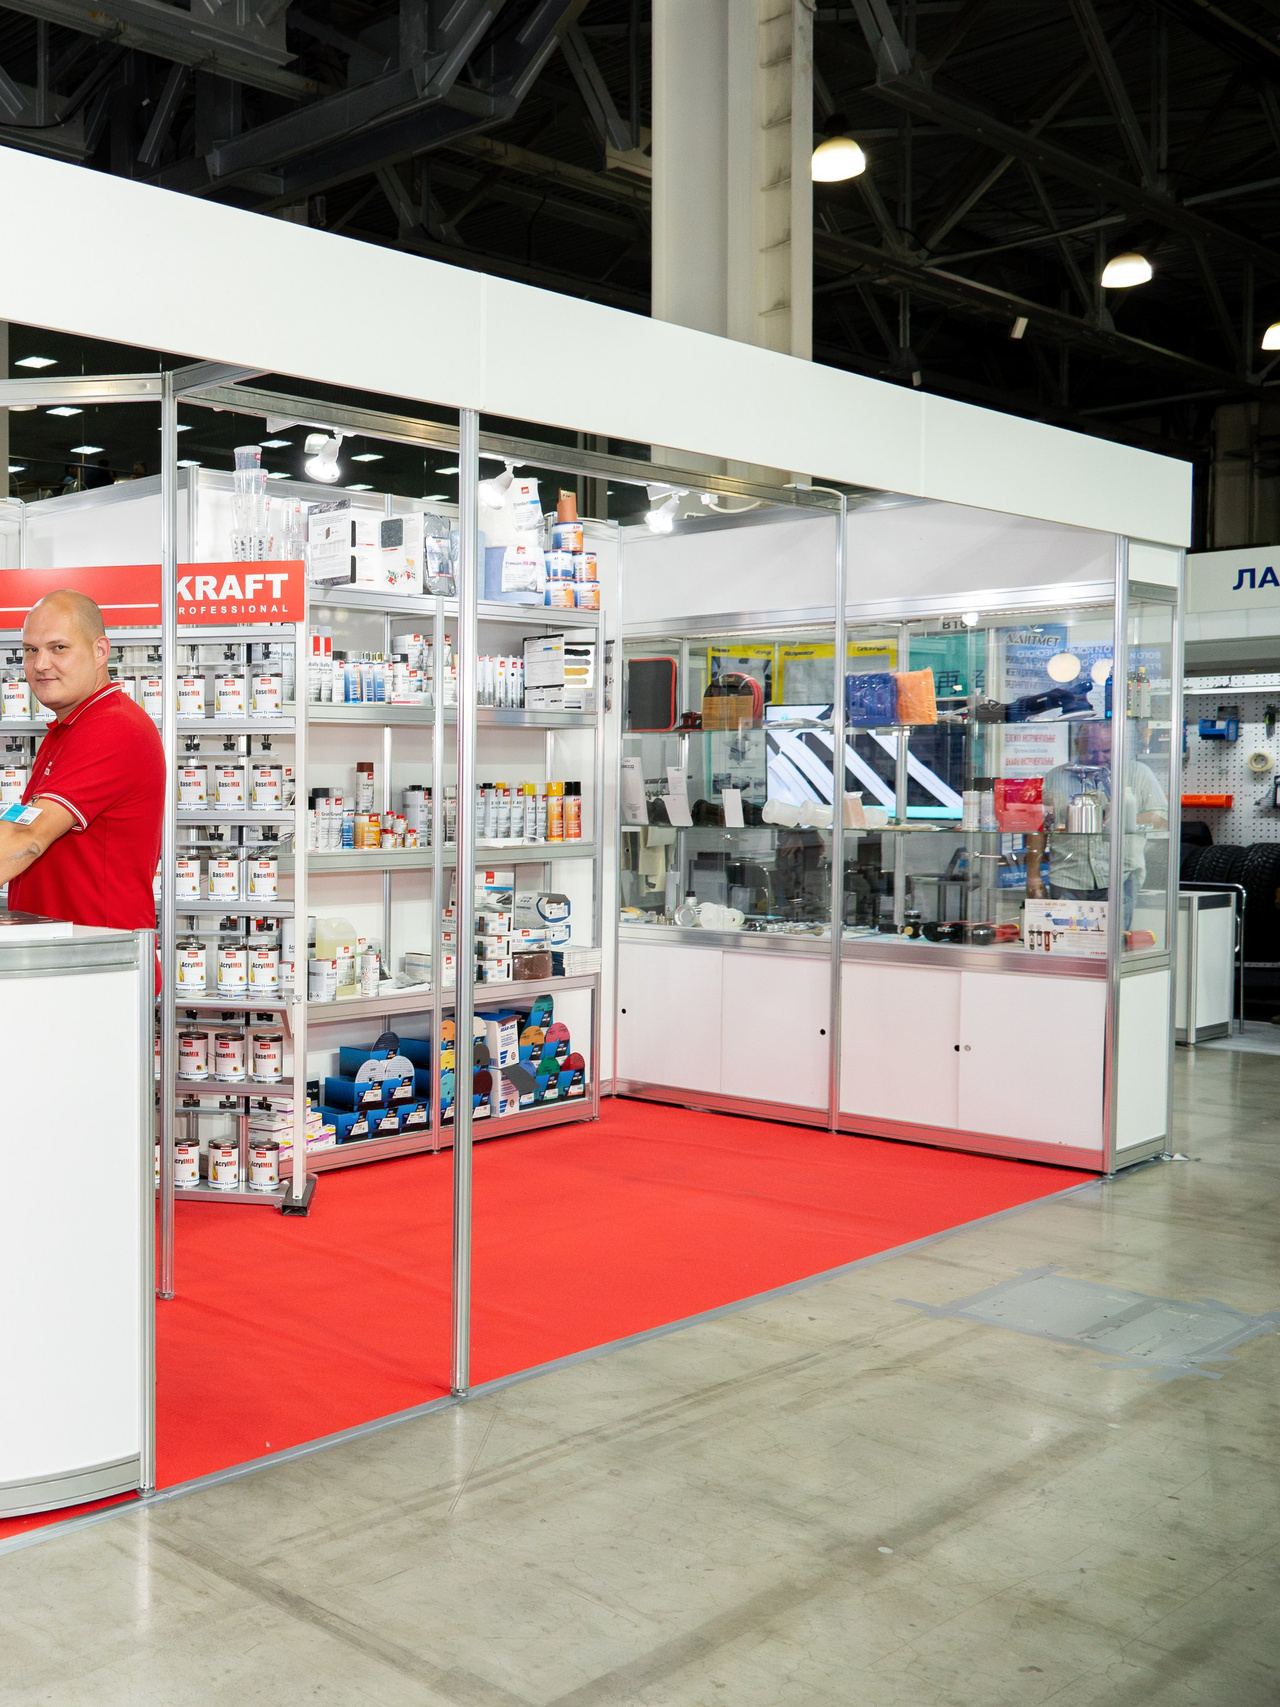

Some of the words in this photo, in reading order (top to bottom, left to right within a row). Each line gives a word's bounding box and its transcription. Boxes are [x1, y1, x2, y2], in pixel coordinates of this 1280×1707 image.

[1232, 566, 1280, 591] ЛА
[178, 604, 289, 615] ROFESSIONAL
[174, 1158, 195, 1166] crylMIX
[214, 1160, 237, 1168] AcrylMIX
